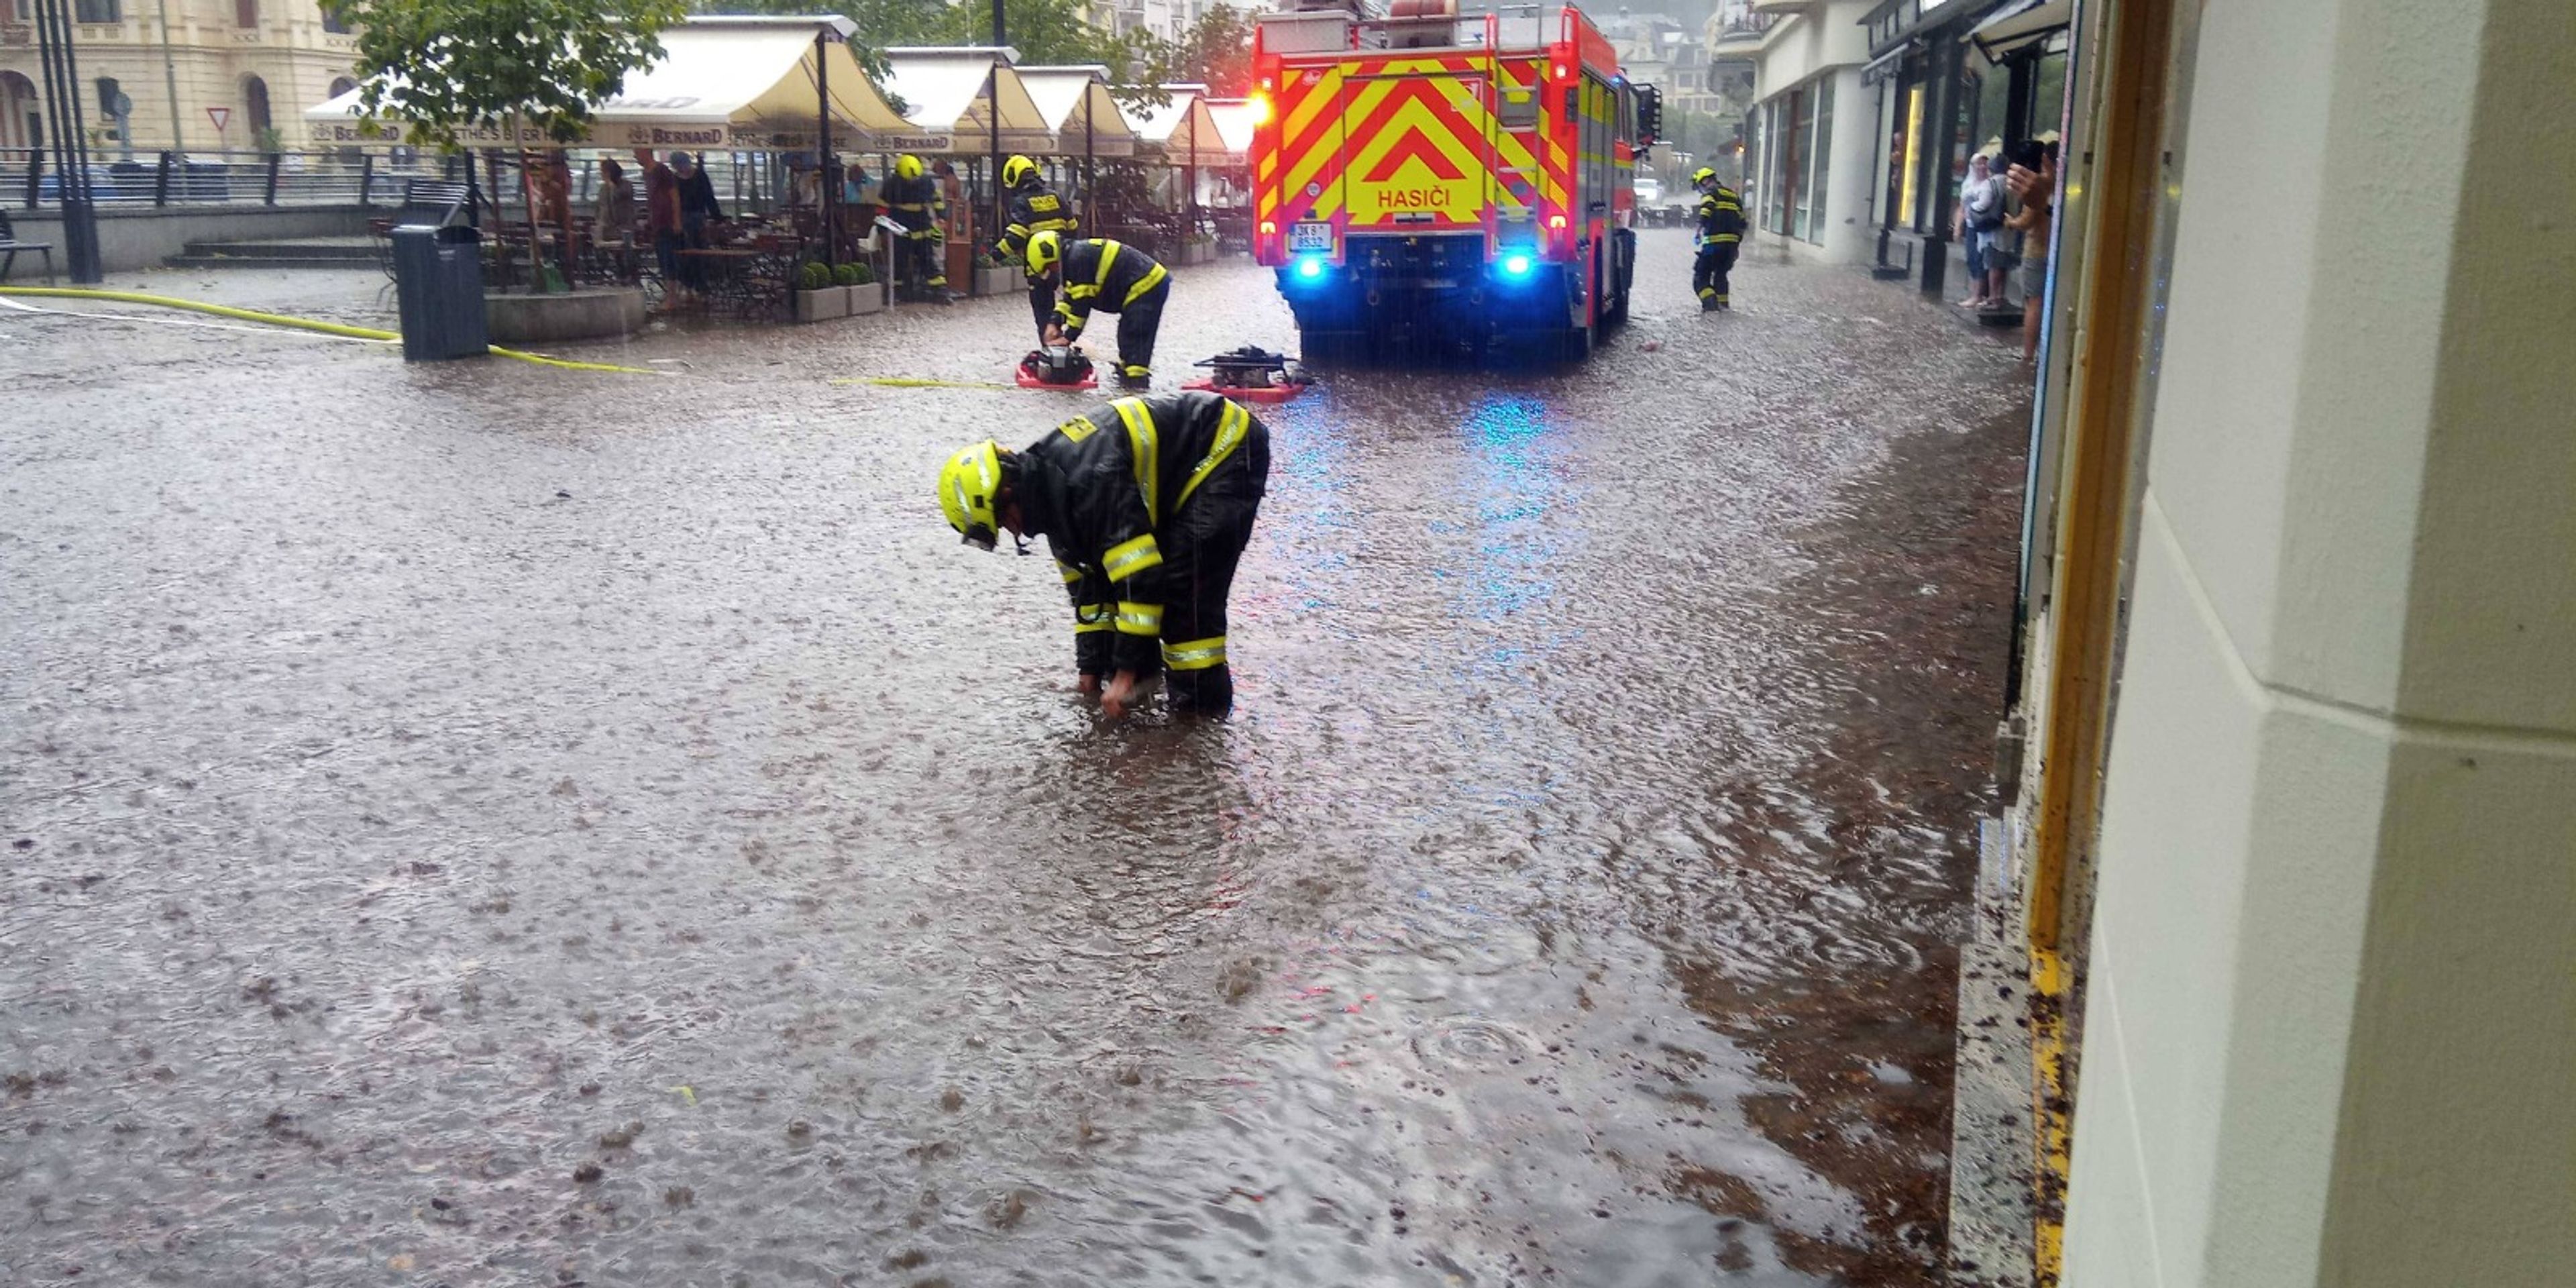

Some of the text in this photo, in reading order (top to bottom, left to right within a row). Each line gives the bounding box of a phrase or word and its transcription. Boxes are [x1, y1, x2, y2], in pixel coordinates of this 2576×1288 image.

[504, 127, 540, 142] BER
[652, 129, 722, 144] BERNARD
[893, 137, 948, 149] BERNARD
[1378, 184, 1450, 207] HASIČI
